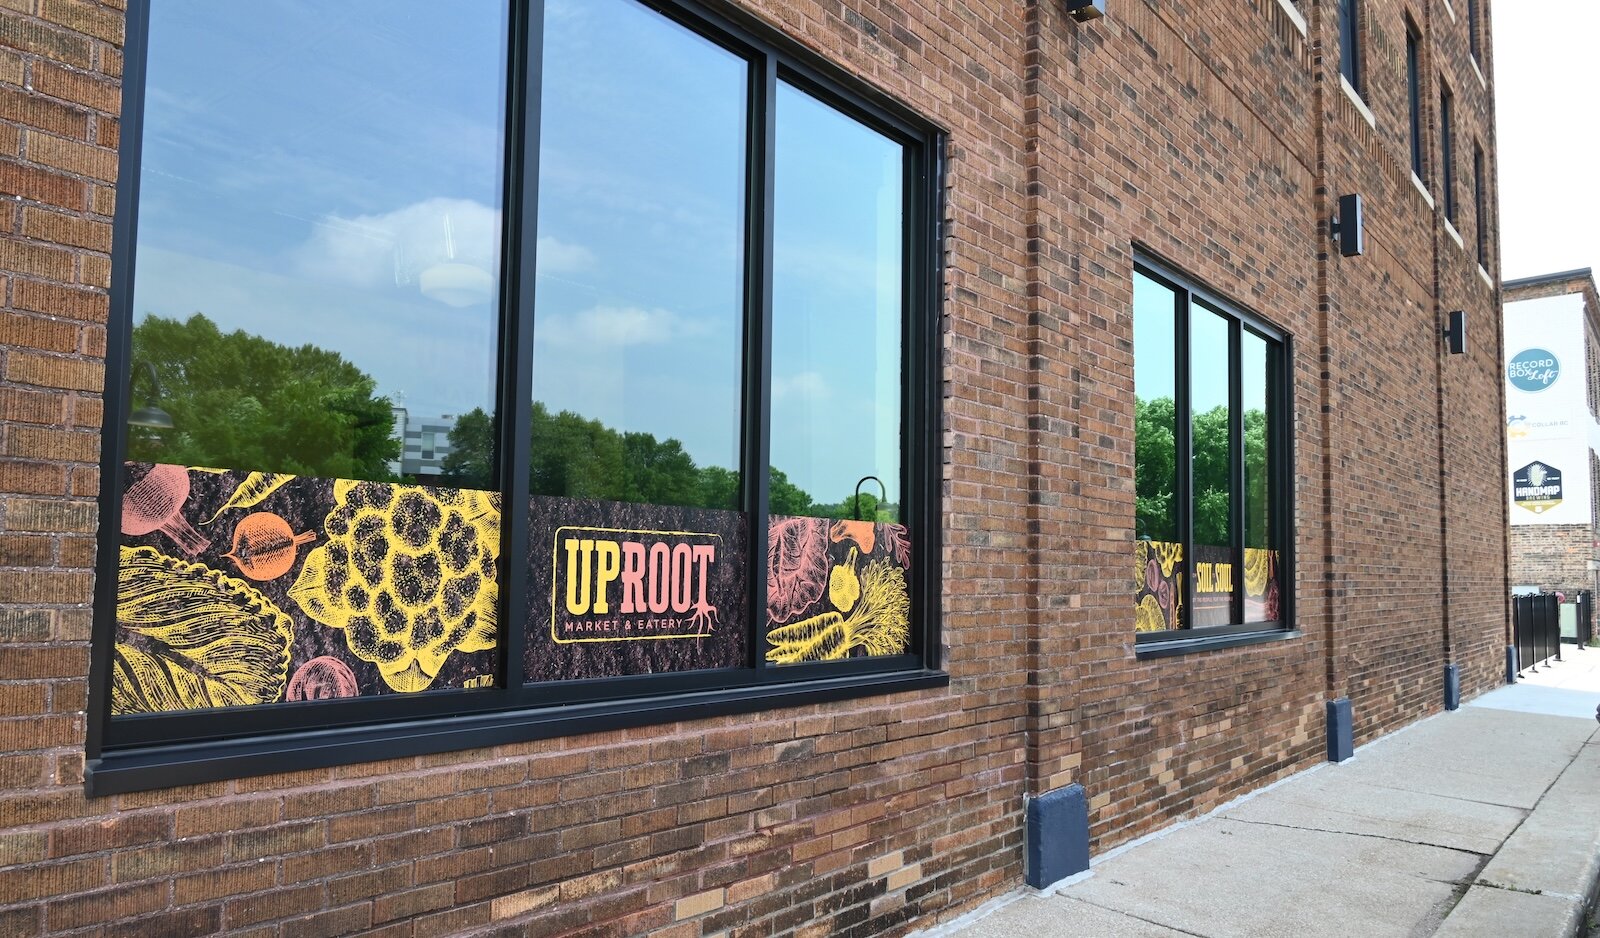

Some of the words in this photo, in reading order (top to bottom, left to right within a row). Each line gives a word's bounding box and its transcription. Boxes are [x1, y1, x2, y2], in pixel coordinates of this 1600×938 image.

[1509, 358, 1554, 371] RECORD
[1509, 368, 1532, 378] BOX
[1527, 368, 1559, 385] Loft
[1515, 485, 1560, 497] HANDMAP
[565, 538, 719, 624] UPROOT
[1196, 562, 1214, 593] SOIL
[1215, 563, 1233, 593] SOUL
[565, 620, 619, 632] MARKET
[624, 620, 632, 630] &
[637, 618, 683, 630] EATERY
